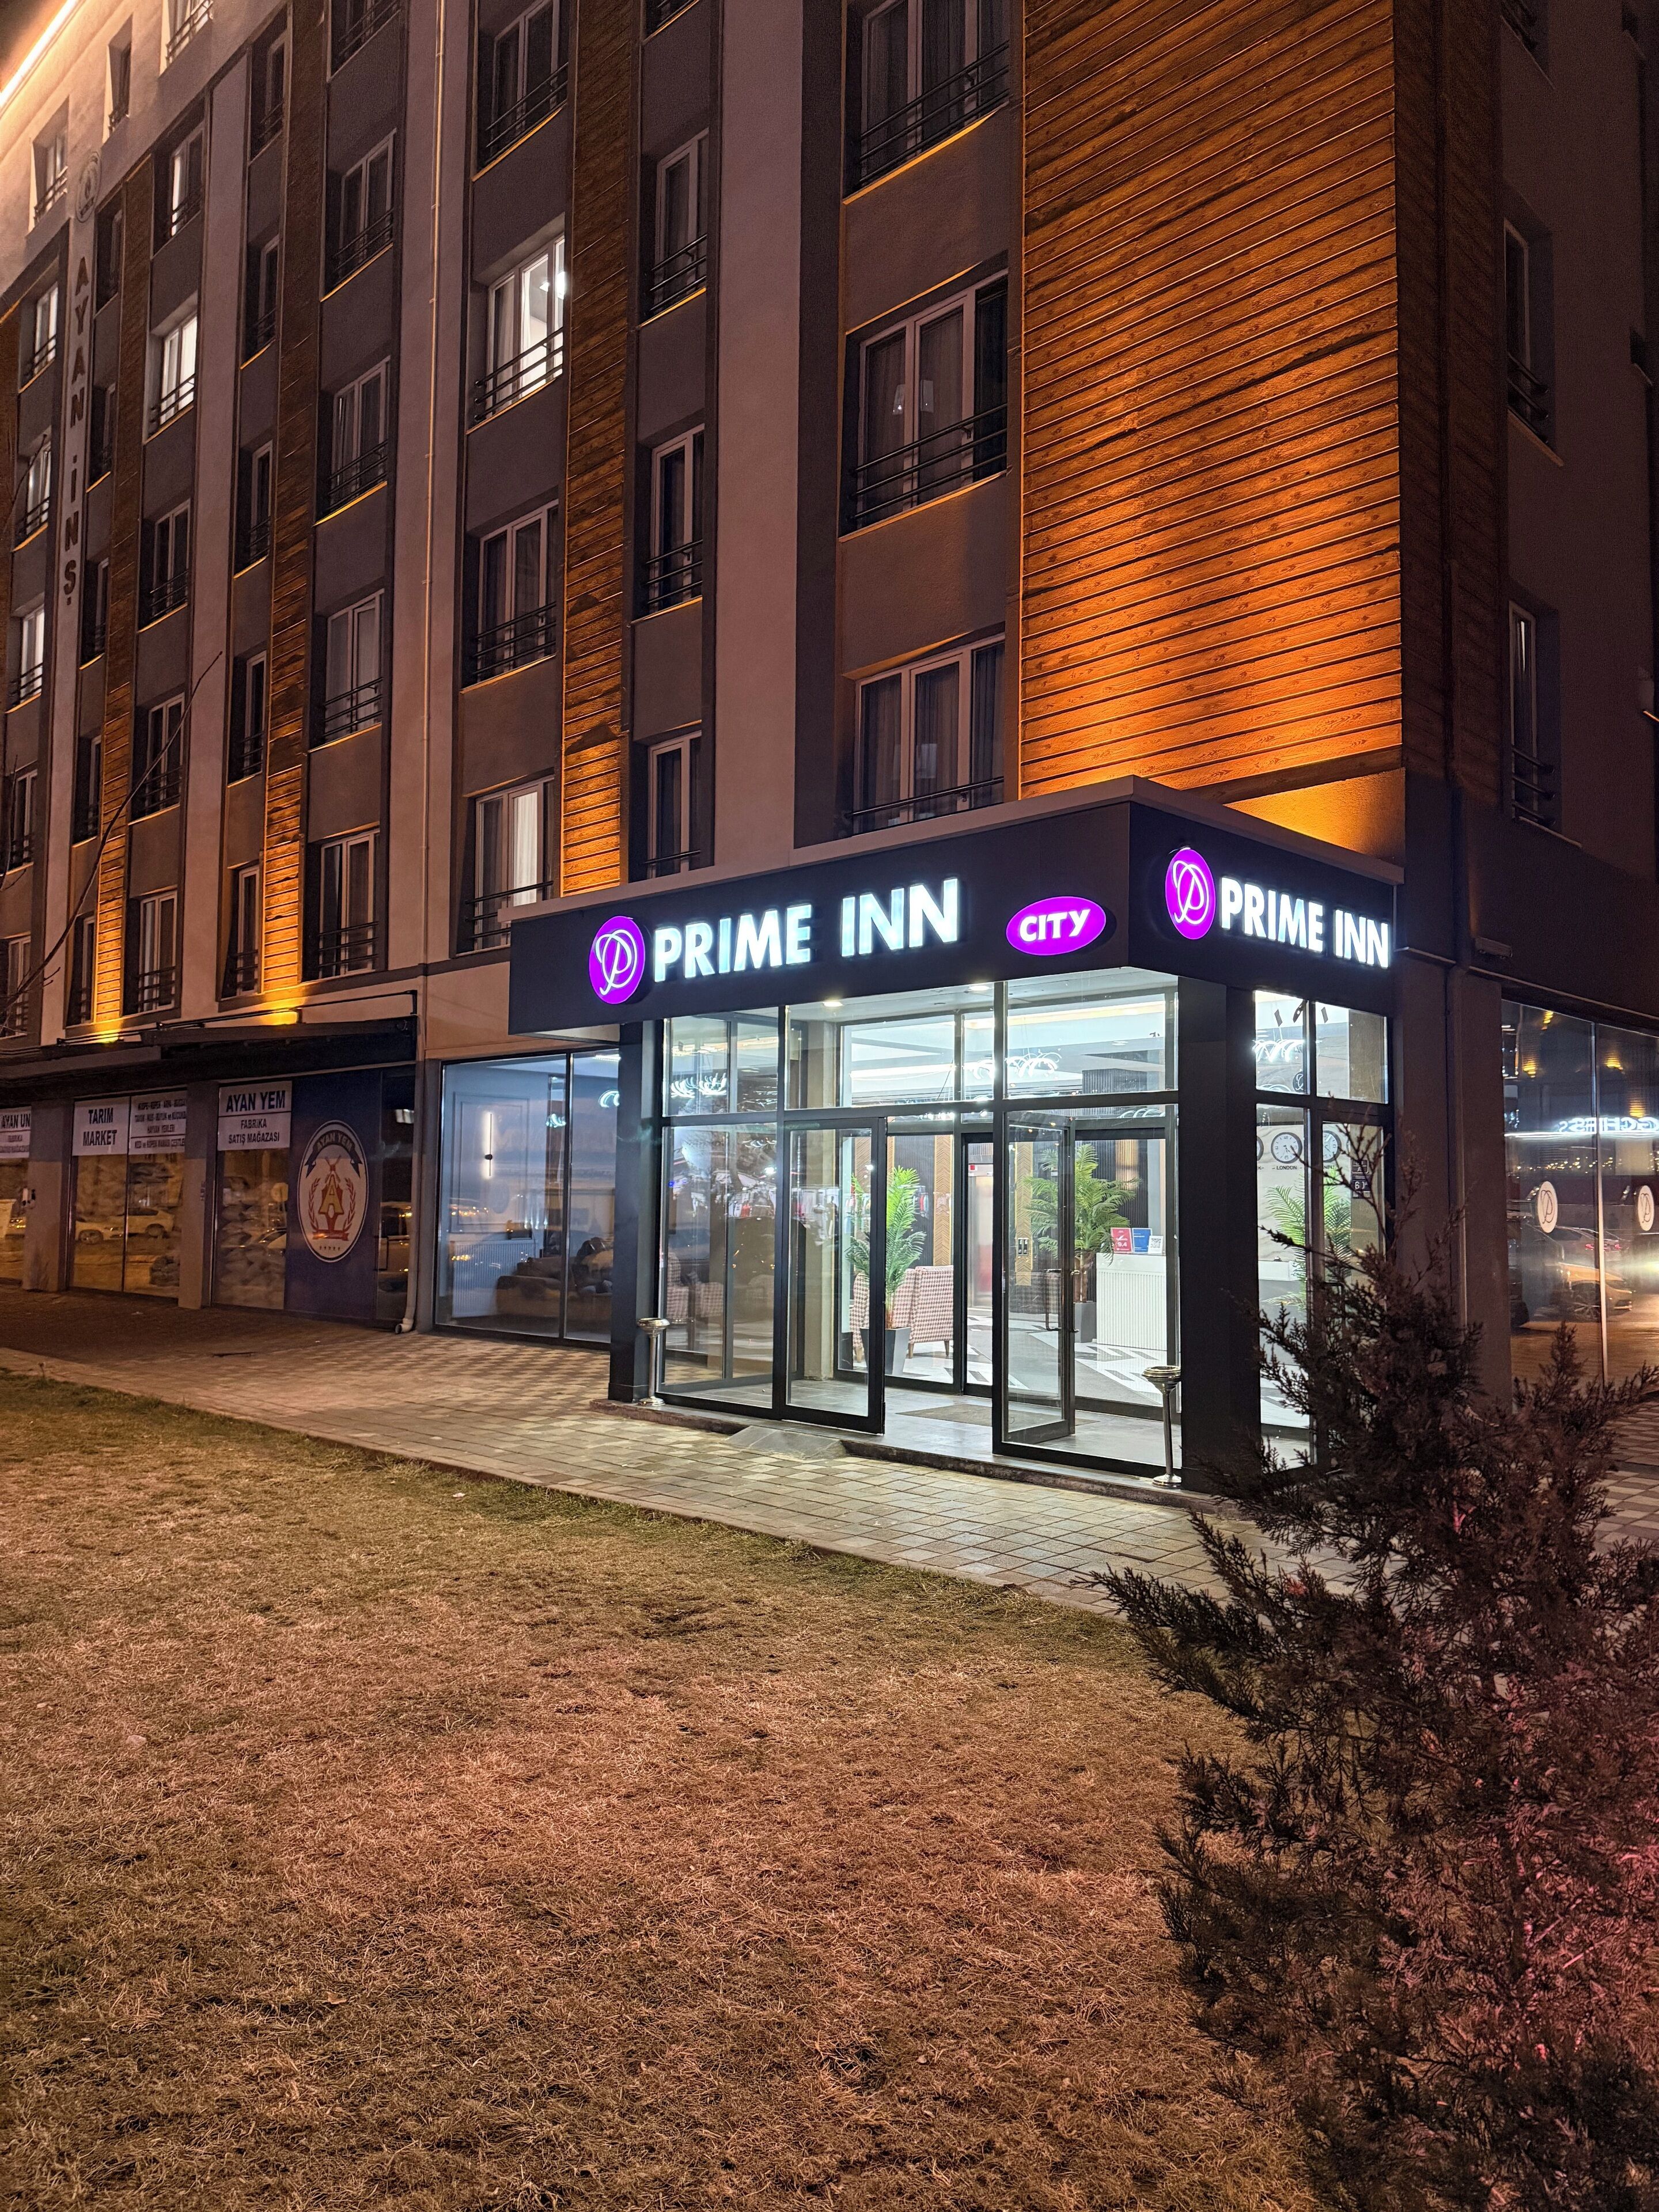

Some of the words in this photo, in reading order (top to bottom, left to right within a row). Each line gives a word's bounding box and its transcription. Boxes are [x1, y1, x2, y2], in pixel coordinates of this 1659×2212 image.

[70, 256, 89, 428] AYAN
[654, 904, 813, 983] PRIME
[840, 877, 959, 958] INN
[1019, 908, 1090, 942] CITY
[1221, 876, 1324, 953] PRIME
[1334, 908, 1389, 969] INN
[226, 1093, 256, 1112] AYAN
[260, 1090, 286, 1110] YEM
[21, 1113, 31, 1127] UN
[89, 1107, 113, 1124] TARIM
[83, 1130, 117, 1146] MARKET
